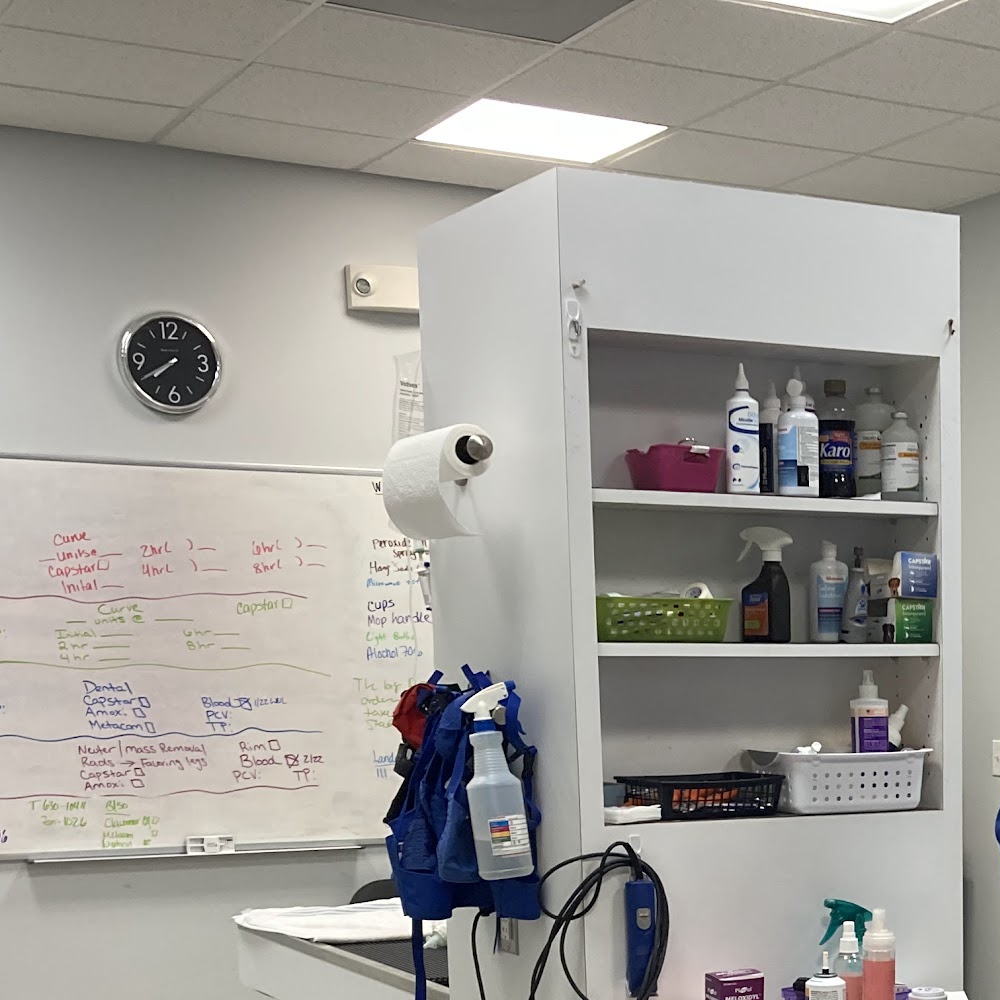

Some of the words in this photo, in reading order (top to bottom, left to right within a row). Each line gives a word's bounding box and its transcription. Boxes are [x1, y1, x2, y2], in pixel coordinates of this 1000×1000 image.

[158, 321, 179, 340] 12
[132, 352, 146, 371] 9
[197, 354, 209, 373] 3
[168, 385, 181, 404] 6
[820, 443, 851, 458] Karo
[82, 680, 133, 695] Dental
